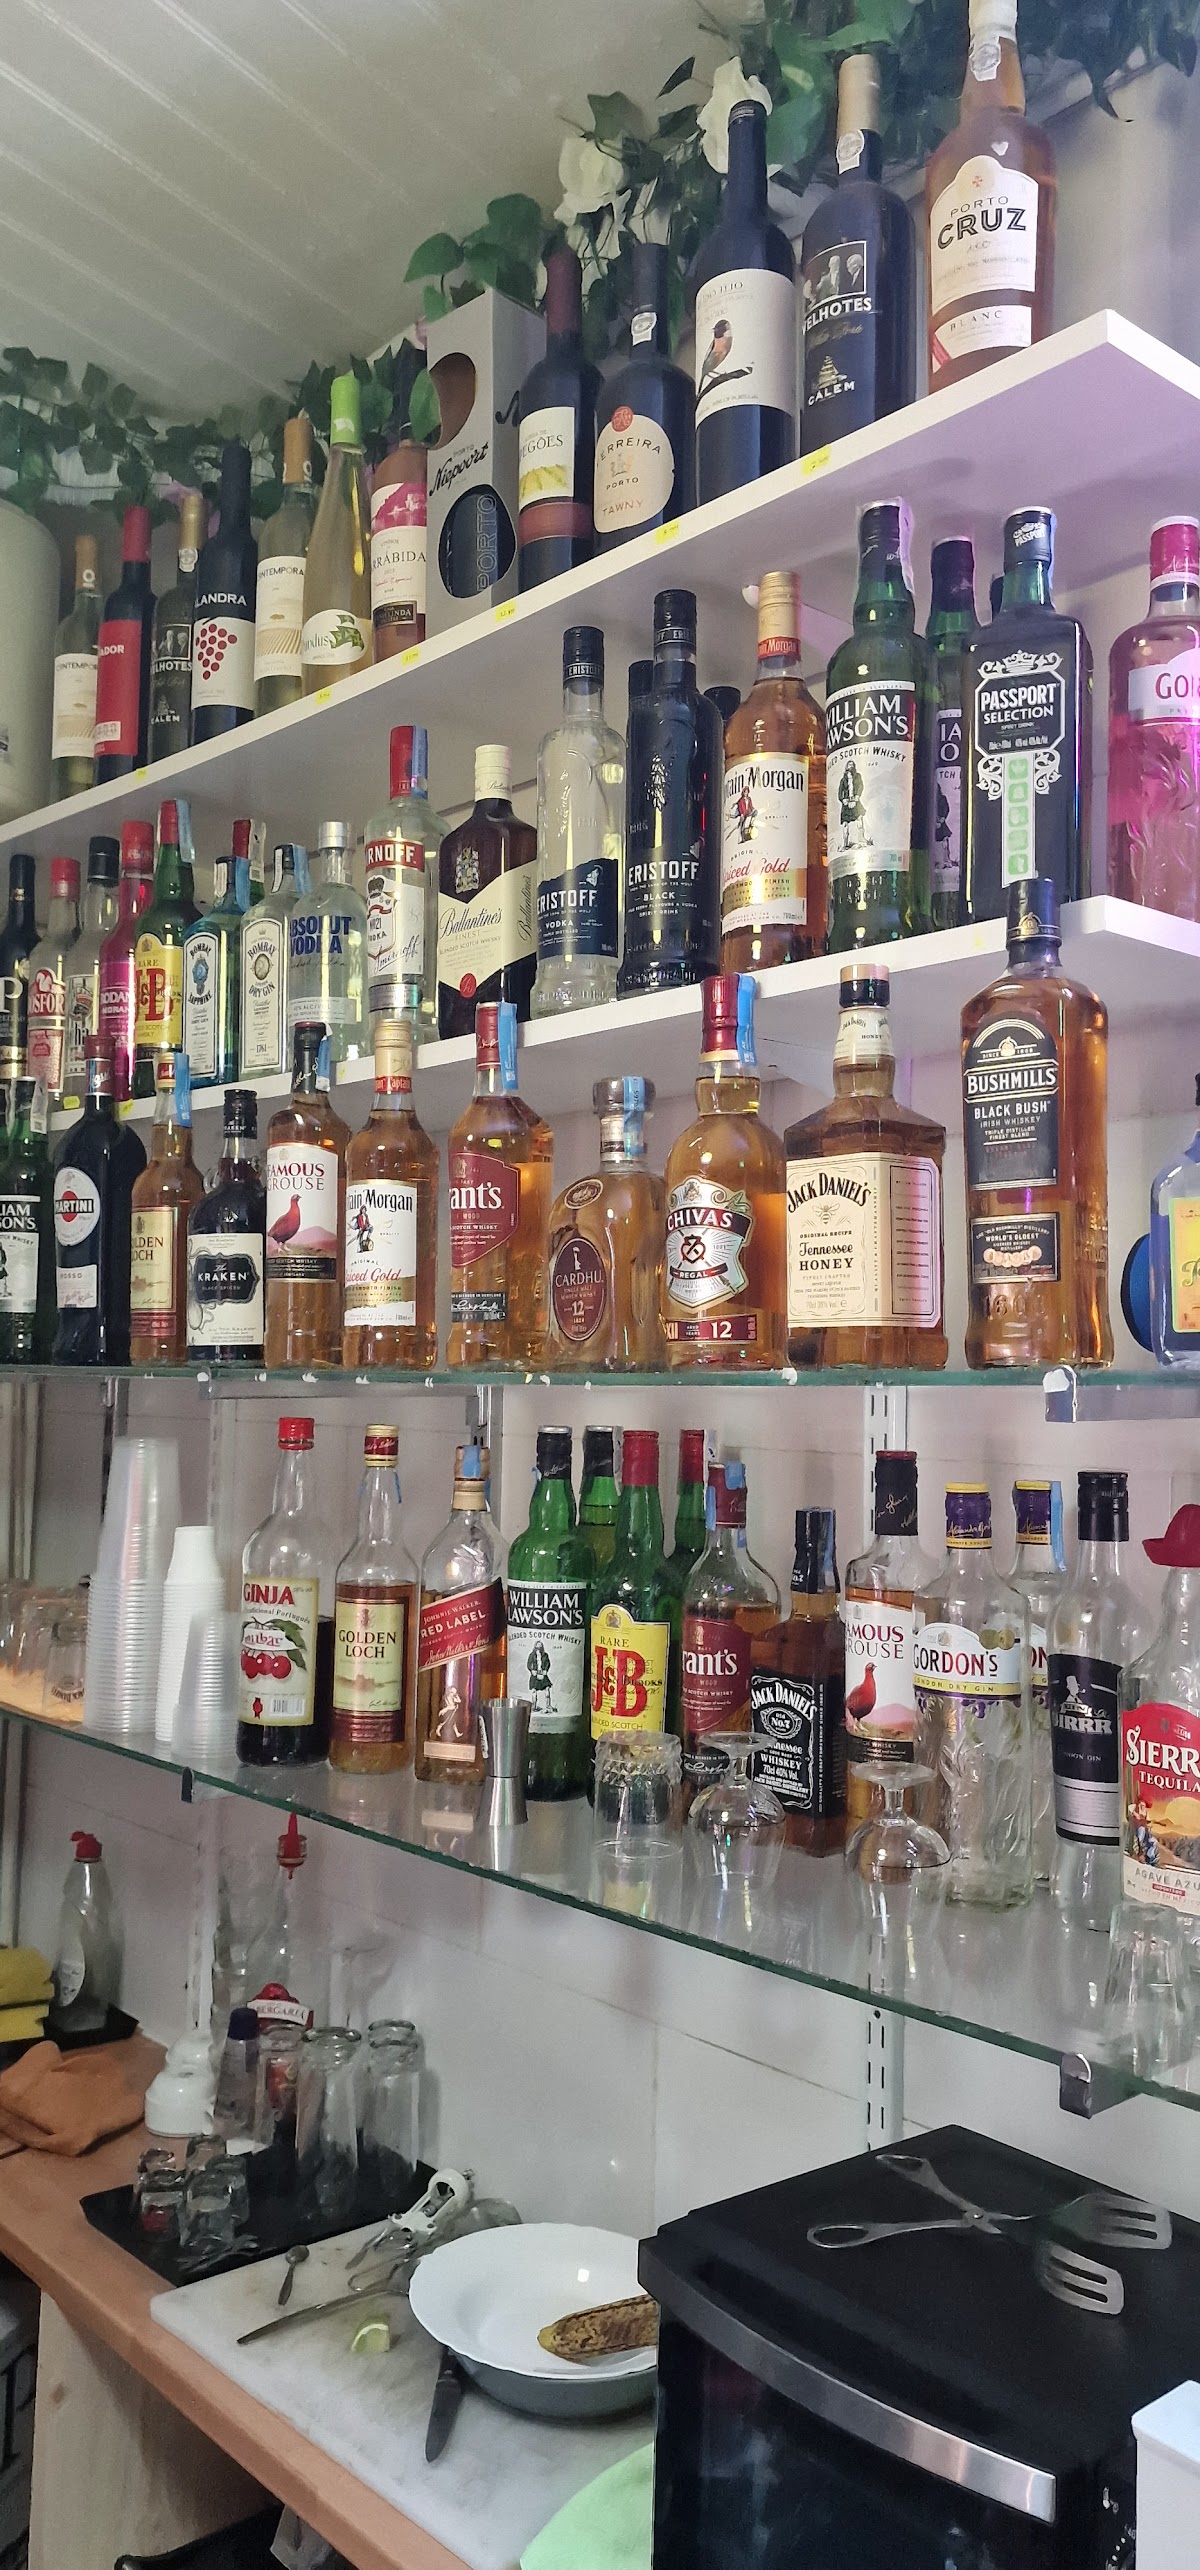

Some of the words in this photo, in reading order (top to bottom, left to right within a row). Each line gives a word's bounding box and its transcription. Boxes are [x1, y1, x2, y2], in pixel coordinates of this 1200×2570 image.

[950, 196, 1009, 218] PORTO
[937, 207, 1026, 250] CRUZ
[950, 310, 1003, 332] BLANC
[598, 437, 661, 466] ERREIRA
[606, 476, 639, 491] PORTO
[602, 499, 644, 517] TAWNY
[476, 495, 496, 592] PORTO
[1014, 528, 1046, 547] PASSPORT
[981, 683, 1057, 712] PASSPORT
[983, 705, 1054, 725] SELECTION
[839, 746, 869, 760] SCOTCH
[872, 746, 907, 763] WHISKY
[745, 766, 805, 793] Morgan
[367, 844, 415, 865] RNOFF
[628, 860, 700, 887] ERISTOFF
[643, 891, 676, 902] BLACK
[517, 875, 532, 943] Ballantine's
[290, 915, 352, 937] BSOUT
[439, 907, 503, 940] Ballantine's
[545, 919, 574, 930] VODKA
[454, 929, 481, 942] FINEST
[190, 943, 212, 960] BOMBAY
[248, 941, 277, 960] BOMBAY
[249, 985, 263, 998] DRY
[262, 982, 276, 997] GIN
[982, 1051, 1000, 1061] SINCE
[966, 1068, 1057, 1095] BUSHMILLS
[974, 1102, 1014, 1120] BLACK
[1015, 1100, 1048, 1115] BUSH
[980, 1118, 1003, 1129] IRISH
[1004, 1115, 1041, 1127] WHISKEY
[984, 1127, 1004, 1136] TRIPLE
[989, 1133, 1008, 1141] FINEST
[1009, 1131, 1030, 1139] BLEND
[267, 1162, 325, 1178] FAMOUS
[267, 1177, 325, 1192] GROUSE
[788, 1180, 818, 1214] JACK
[818, 1172, 872, 1207] DANIEL'S
[363, 1188, 413, 1213] Morgan
[449, 1182, 502, 1210] ant's
[56, 1199, 93, 1213] MARTINI
[0, 1216, 36, 1230] ON'S
[462, 1212, 480, 1220] WOOD
[667, 1208, 733, 1231] CHIVAS
[12, 1235, 34, 1245] WHISKY
[799, 1231, 829, 1239] ORIGINAL
[829, 1229, 853, 1237] RECIPE
[985, 1233, 1013, 1242] WORLD'S
[1014, 1232, 1040, 1241] OLDEST
[798, 1241, 854, 1257] Tennessee
[798, 1257, 854, 1271] HONEY
[197, 1272, 248, 1282] KRAKEN
[370, 1267, 402, 1284] Gold
[555, 1269, 603, 1288] CARDHU
[679, 1271, 709, 1279] REGAL
[571, 1299, 585, 1317] 12
[711, 1321, 733, 1339] 12
[243, 1582, 295, 1605] GINJA
[509, 1590, 579, 1609] WILLIAM
[276, 1608, 312, 1625] Português
[423, 1609, 451, 1626] JOHNNIE
[452, 1600, 479, 1613] WALKER
[508, 1606, 584, 1626] LAWSON'S
[420, 1623, 444, 1639] RED
[446, 1609, 486, 1630] LABEL
[338, 1629, 397, 1645] GOLDEN
[528, 1631, 556, 1640] SCOTCH
[558, 1633, 582, 1646] WHISKY
[600, 1636, 630, 1648] RARE
[345, 1644, 385, 1659] LOCH
[913, 1643, 998, 1677] GORDON'S
[592, 1645, 648, 1717] J&B
[914, 1676, 943, 1689] LONDON
[948, 1683, 968, 1692] DRY
[974, 1685, 994, 1693] GIN
[751, 1685, 775, 1710] JACK
[775, 1681, 818, 1720] DANIEL'S
[611, 1721, 643, 1730] SCOTCH
[770, 1717, 791, 1729] No.7
[872, 1741, 897, 1749] WHISKY
[760, 1753, 802, 1770] WHISKEY
[763, 1764, 776, 1775] 70cl
[775, 1767, 788, 1779] 40%
[788, 1769, 799, 1780] Vol.
[1138, 1770, 1200, 1793] TEQUILA
[1135, 1867, 1171, 1884] AGAVE
